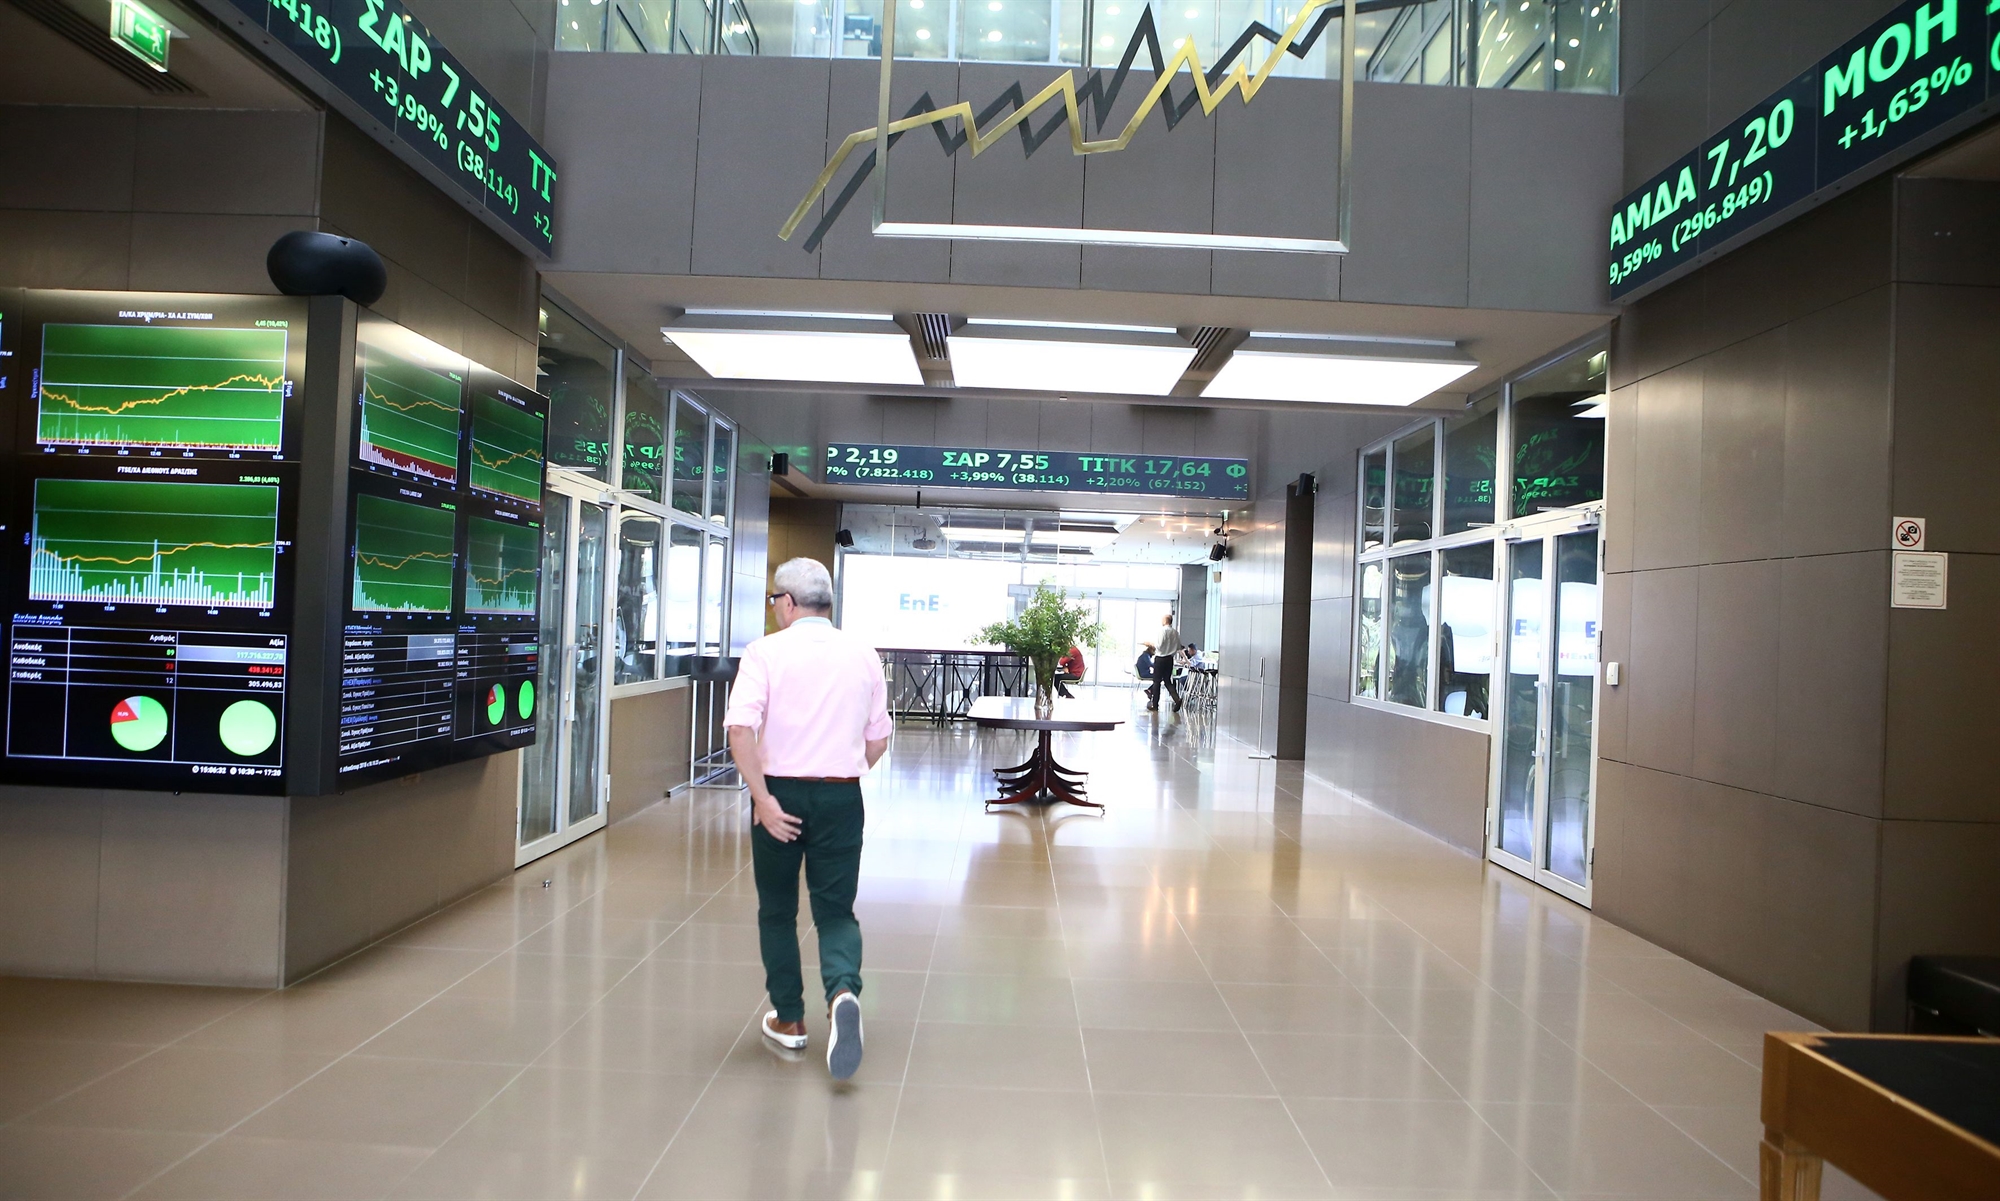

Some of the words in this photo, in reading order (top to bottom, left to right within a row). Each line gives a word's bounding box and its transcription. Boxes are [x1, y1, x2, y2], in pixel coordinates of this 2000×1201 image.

[1823, 0, 1958, 117] ΜΟΗ
[1837, 55, 1973, 150] +1,63%
[369, 68, 448, 150] +3,99%
[457, 140, 519, 214] (38.114)
[441, 61, 501, 153] 7,55
[528, 149, 557, 203] ΤΙ
[1707, 99, 1794, 190] 7,20
[1609, 238, 1663, 285] 9,59%
[1671, 170, 1774, 253] (296.849)
[845, 448, 898, 466] 2,19
[942, 451, 990, 467] ΣΑΡ
[997, 453, 1049, 471] 7,55
[1078, 456, 1136, 474] ΤΙΤΚ
[1144, 459, 1211, 478] 17,64
[1226, 463, 1246, 478] Φ
[855, 466, 934, 481] (7.822.418)
[950, 471, 1005, 483] +3,99%
[1012, 473, 1070, 487] (38.114)
[1086, 476, 1140, 488] +2,20%
[1148, 479, 1206, 492] (67.152)
[13, 642, 42, 652] Ανοδικές
[149, 634, 176, 643] Αριθμός
[269, 638, 284, 646] Αξία
[12, 671, 42, 680] Σταθερές
[13, 657, 46, 666] Καθοδικές
